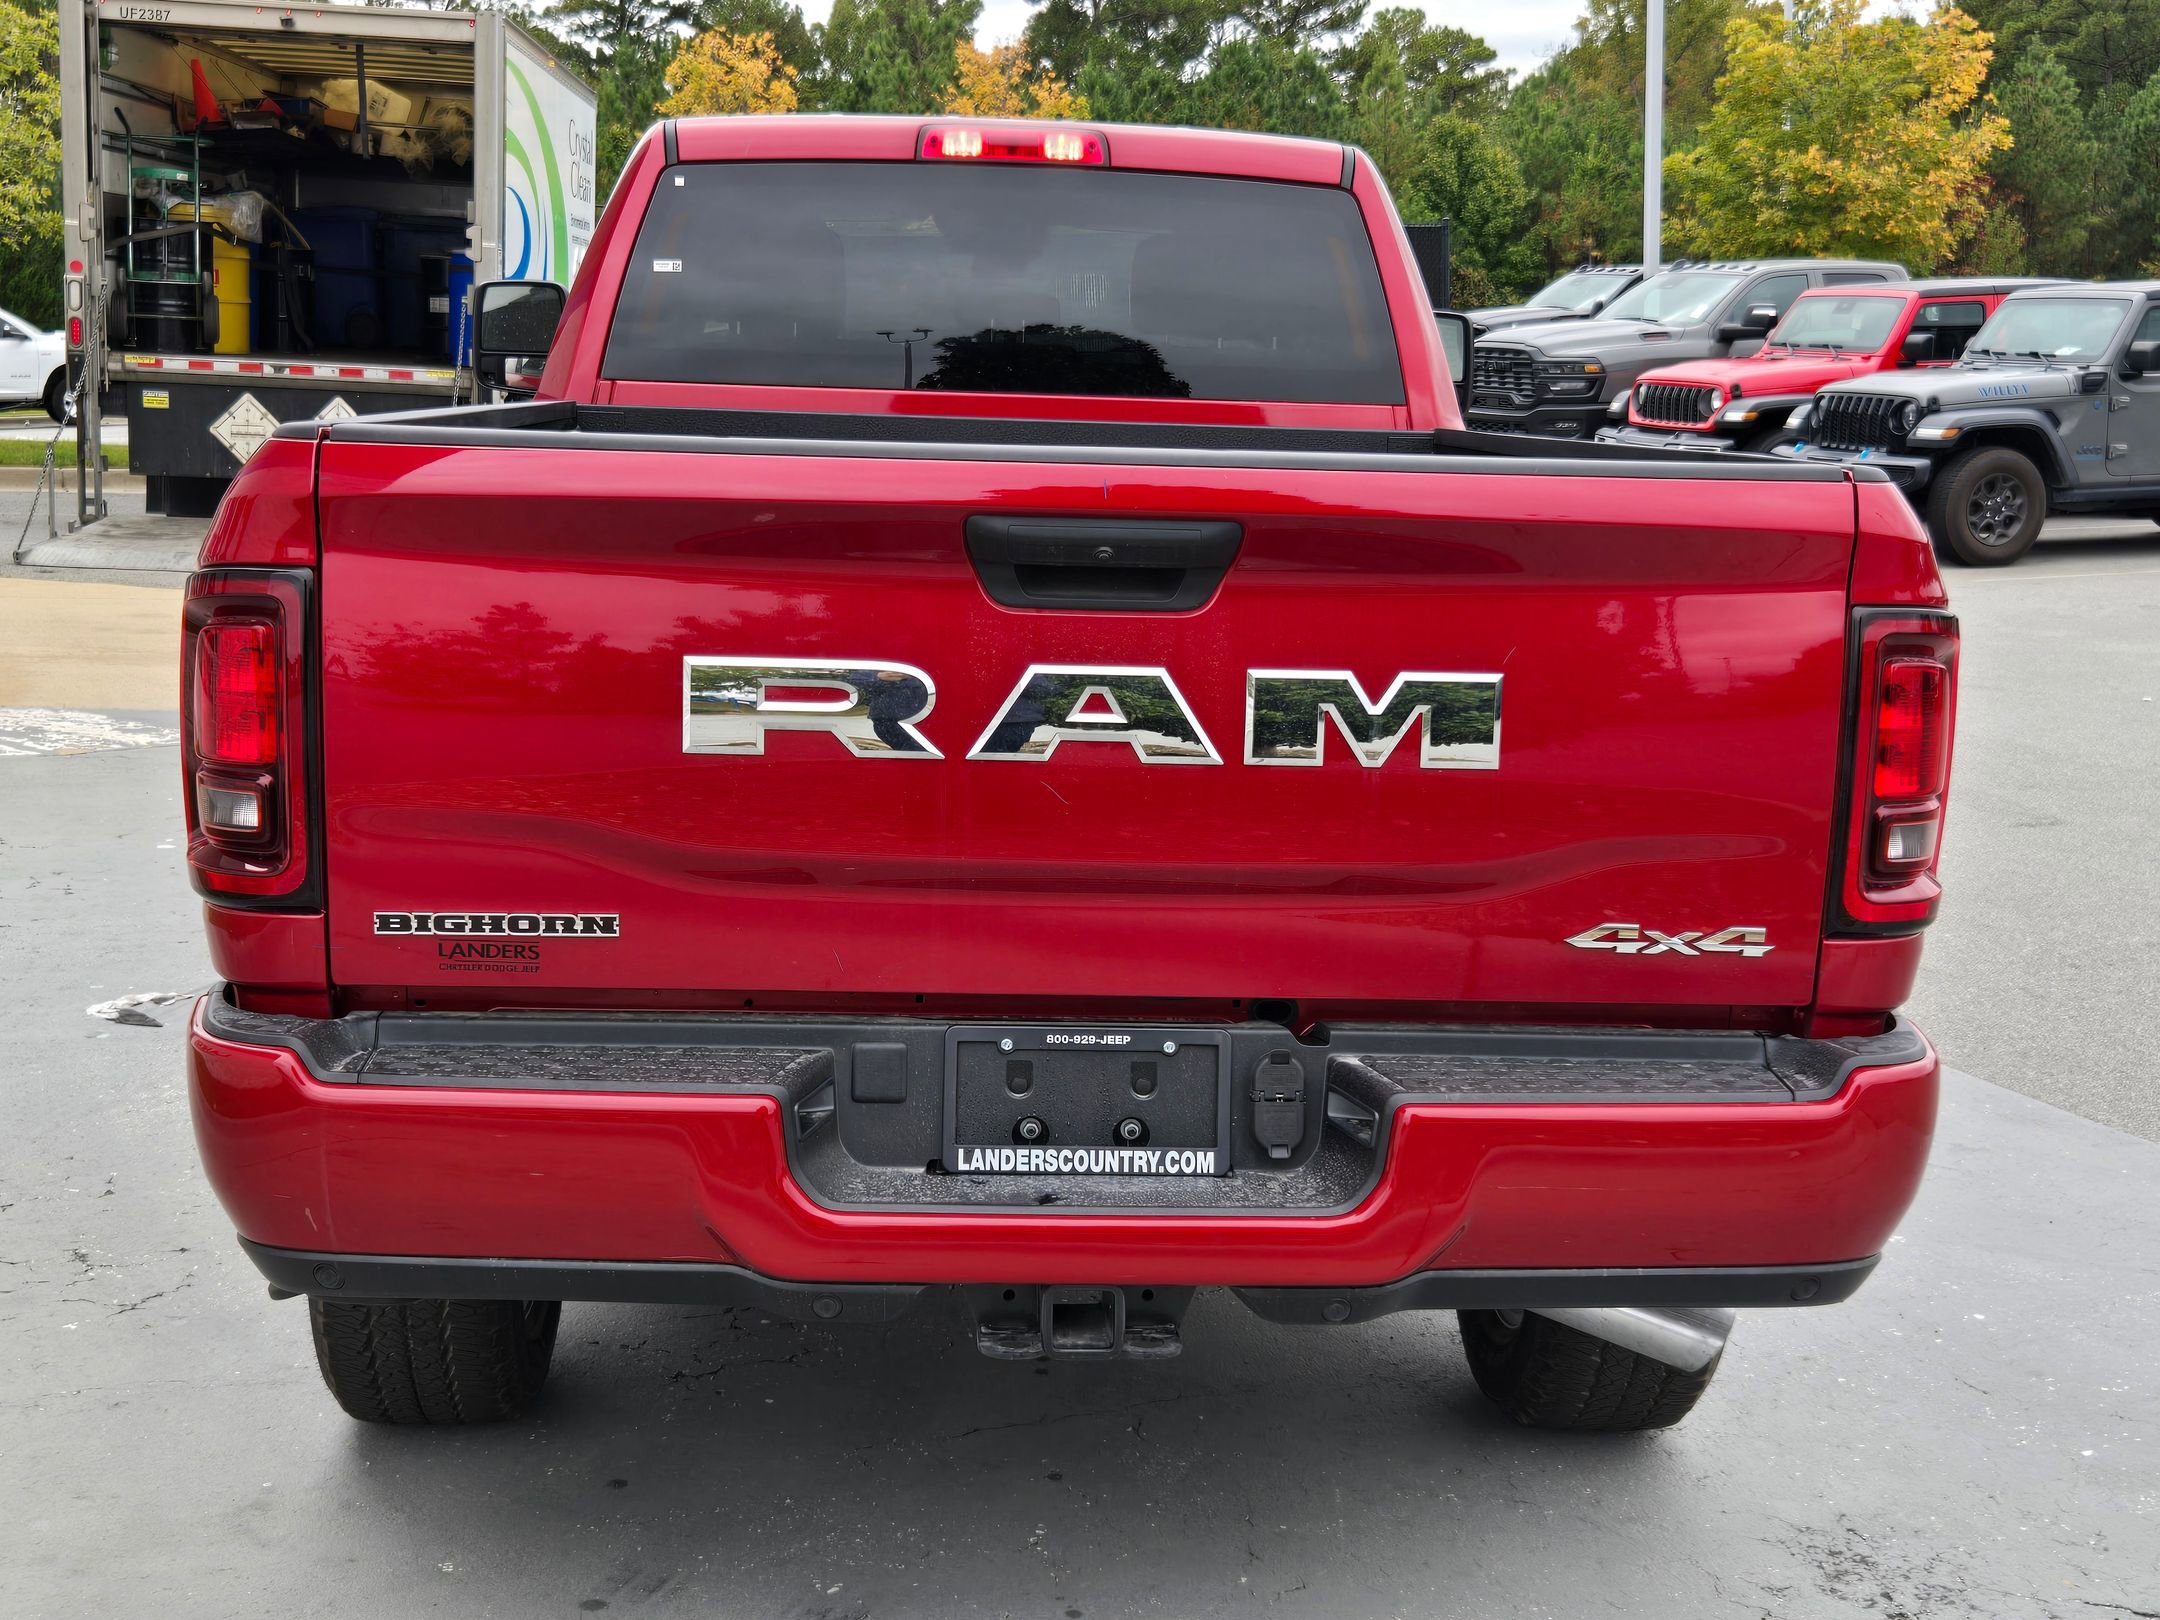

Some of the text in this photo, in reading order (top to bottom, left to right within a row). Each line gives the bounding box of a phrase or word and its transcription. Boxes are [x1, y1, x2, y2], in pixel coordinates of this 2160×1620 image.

[120, 6, 171, 21] UF2387
[568, 119, 593, 166] Crystal
[570, 161, 592, 204] Clean
[682, 655, 1505, 769] RAM
[374, 912, 620, 937] BIGHORN
[438, 942, 541, 961] LANDERS
[1563, 922, 1776, 957] 4x4
[1046, 1034, 1132, 1046] 800-929-JEEP
[957, 1148, 1215, 1174] LANDERSCOUNTRY.COM
